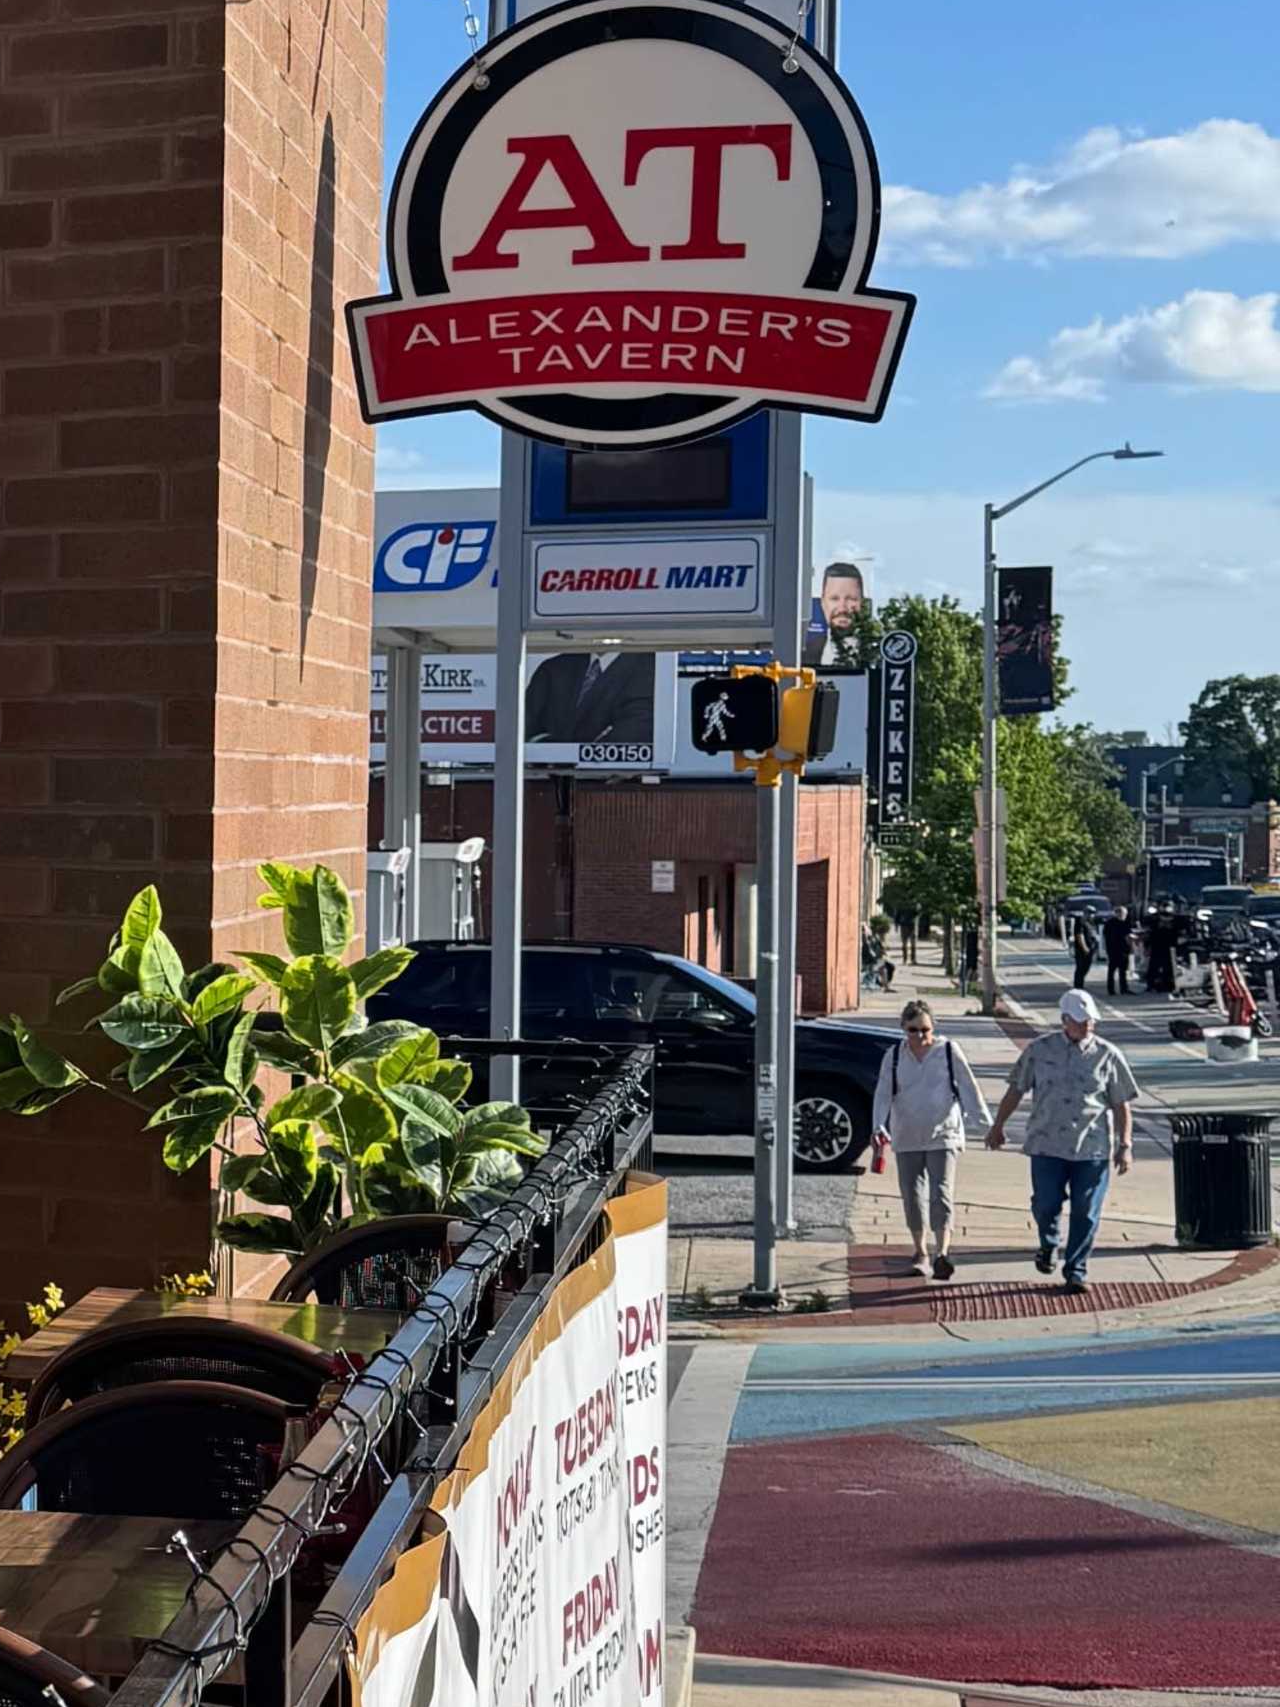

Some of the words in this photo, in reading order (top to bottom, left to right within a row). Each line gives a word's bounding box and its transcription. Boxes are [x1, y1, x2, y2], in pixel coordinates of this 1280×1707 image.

[452, 124, 792, 272] AT
[403, 303, 852, 352] ALEXANDER'S
[498, 342, 746, 375] TAVERN
[540, 568, 660, 592] CARROLL
[665, 565, 754, 589] MART
[580, 745, 652, 762] 030150
[562, 1556, 619, 1667] FRIDAY
